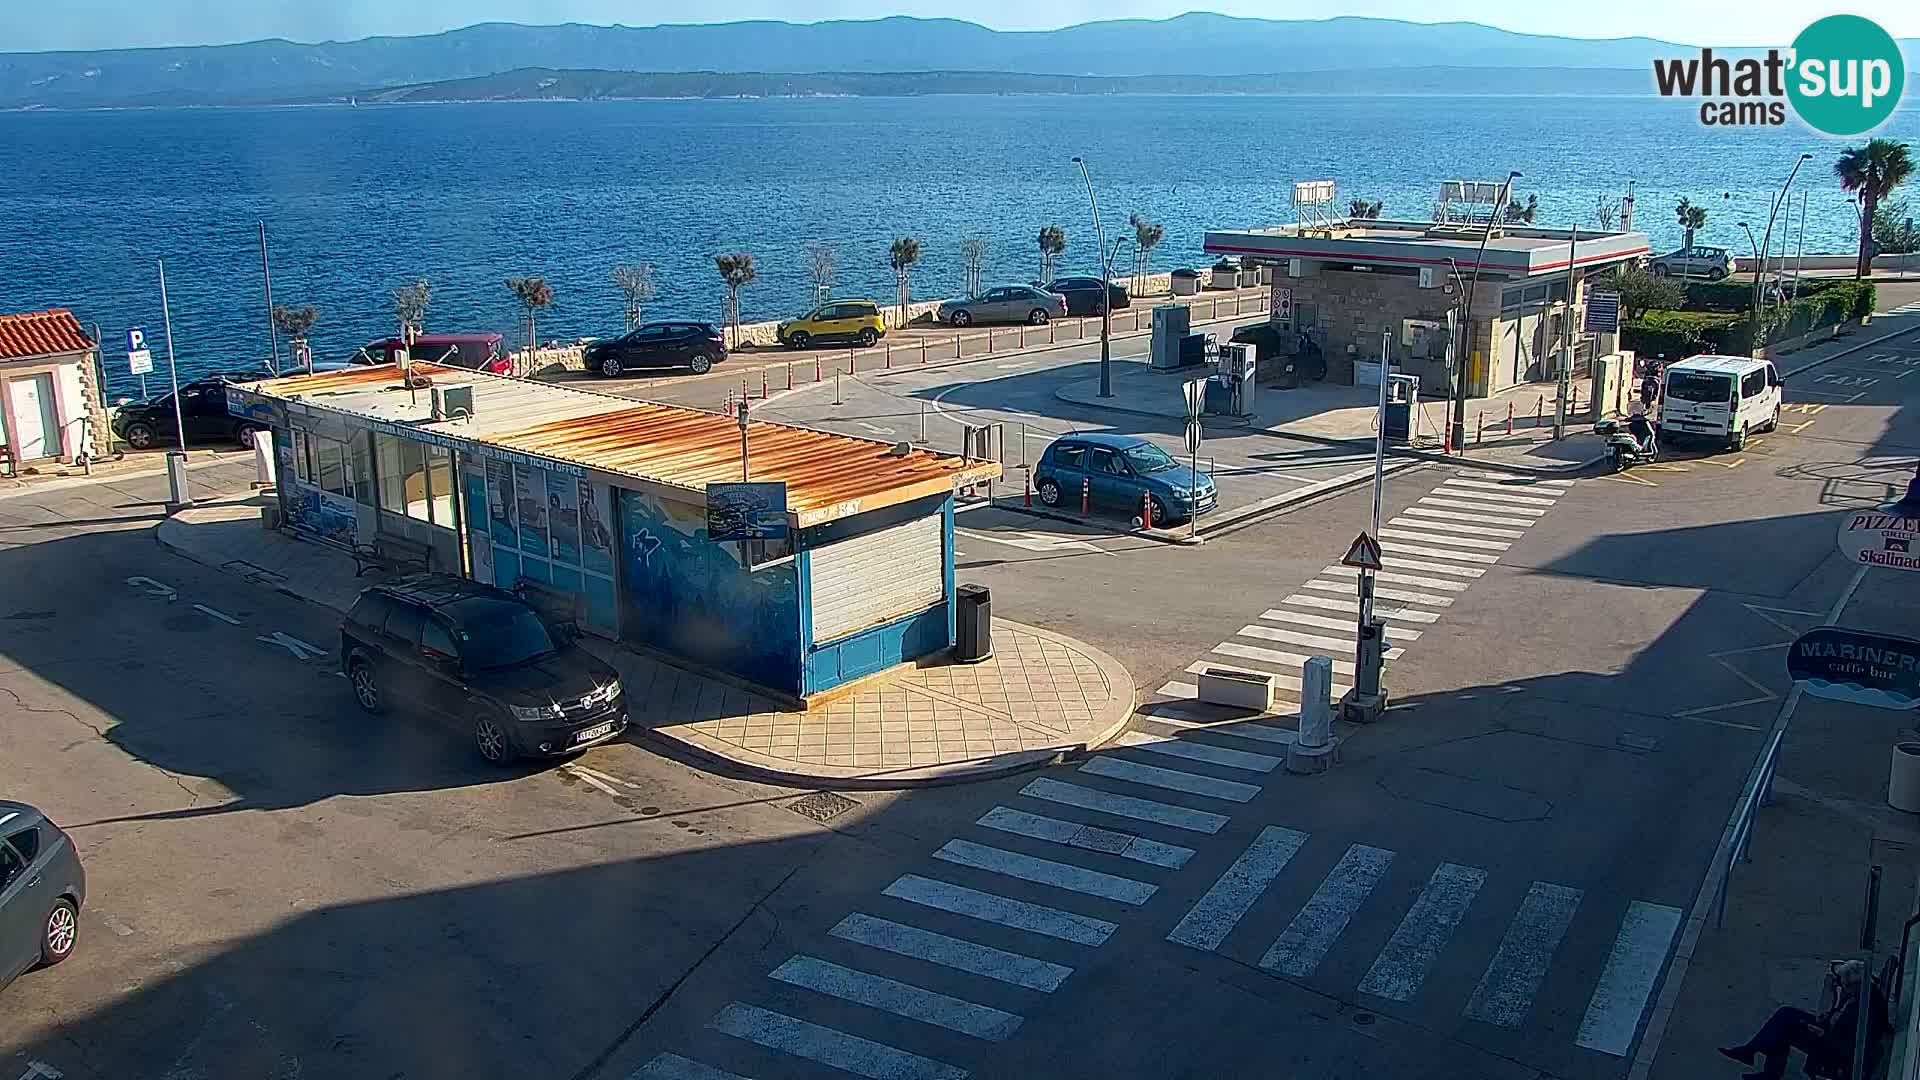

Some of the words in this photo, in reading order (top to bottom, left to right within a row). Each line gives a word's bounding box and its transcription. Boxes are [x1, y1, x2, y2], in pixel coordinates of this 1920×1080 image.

[131, 330, 144, 350] P
[1814, 374, 1880, 387] TAXI
[397, 426, 436, 446] AUTOBUSNA
[495, 449, 527, 465] STATION
[529, 456, 556, 471] TICKET
[556, 462, 583, 477] OFFICE
[1847, 515, 1920, 533] PIZZE
[1800, 642, 1920, 672] MARINER
[1870, 664, 1897, 680] bar
